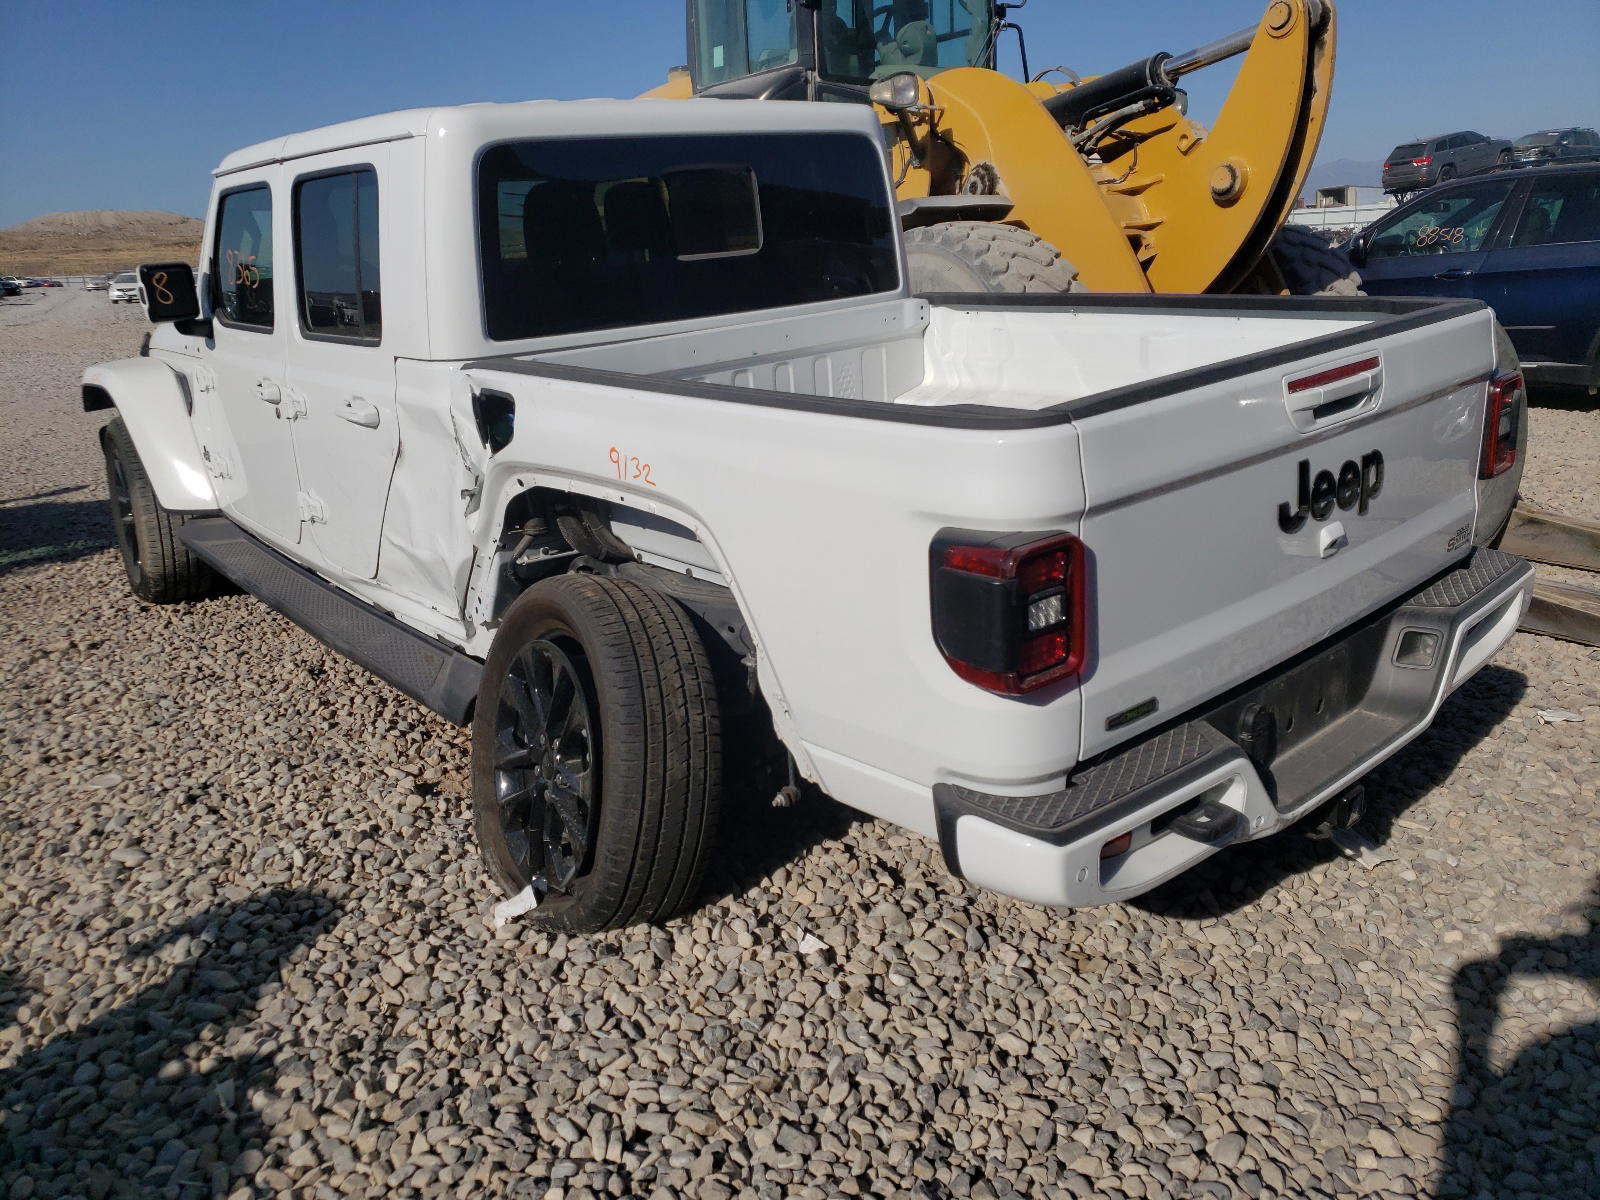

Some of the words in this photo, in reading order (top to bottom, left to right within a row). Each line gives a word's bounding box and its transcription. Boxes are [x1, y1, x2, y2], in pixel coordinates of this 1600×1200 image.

[1416, 224, 1465, 247] 88518
[152, 271, 175, 305] 8
[608, 446, 657, 487] 9132
[1277, 448, 1386, 535] Jeep
